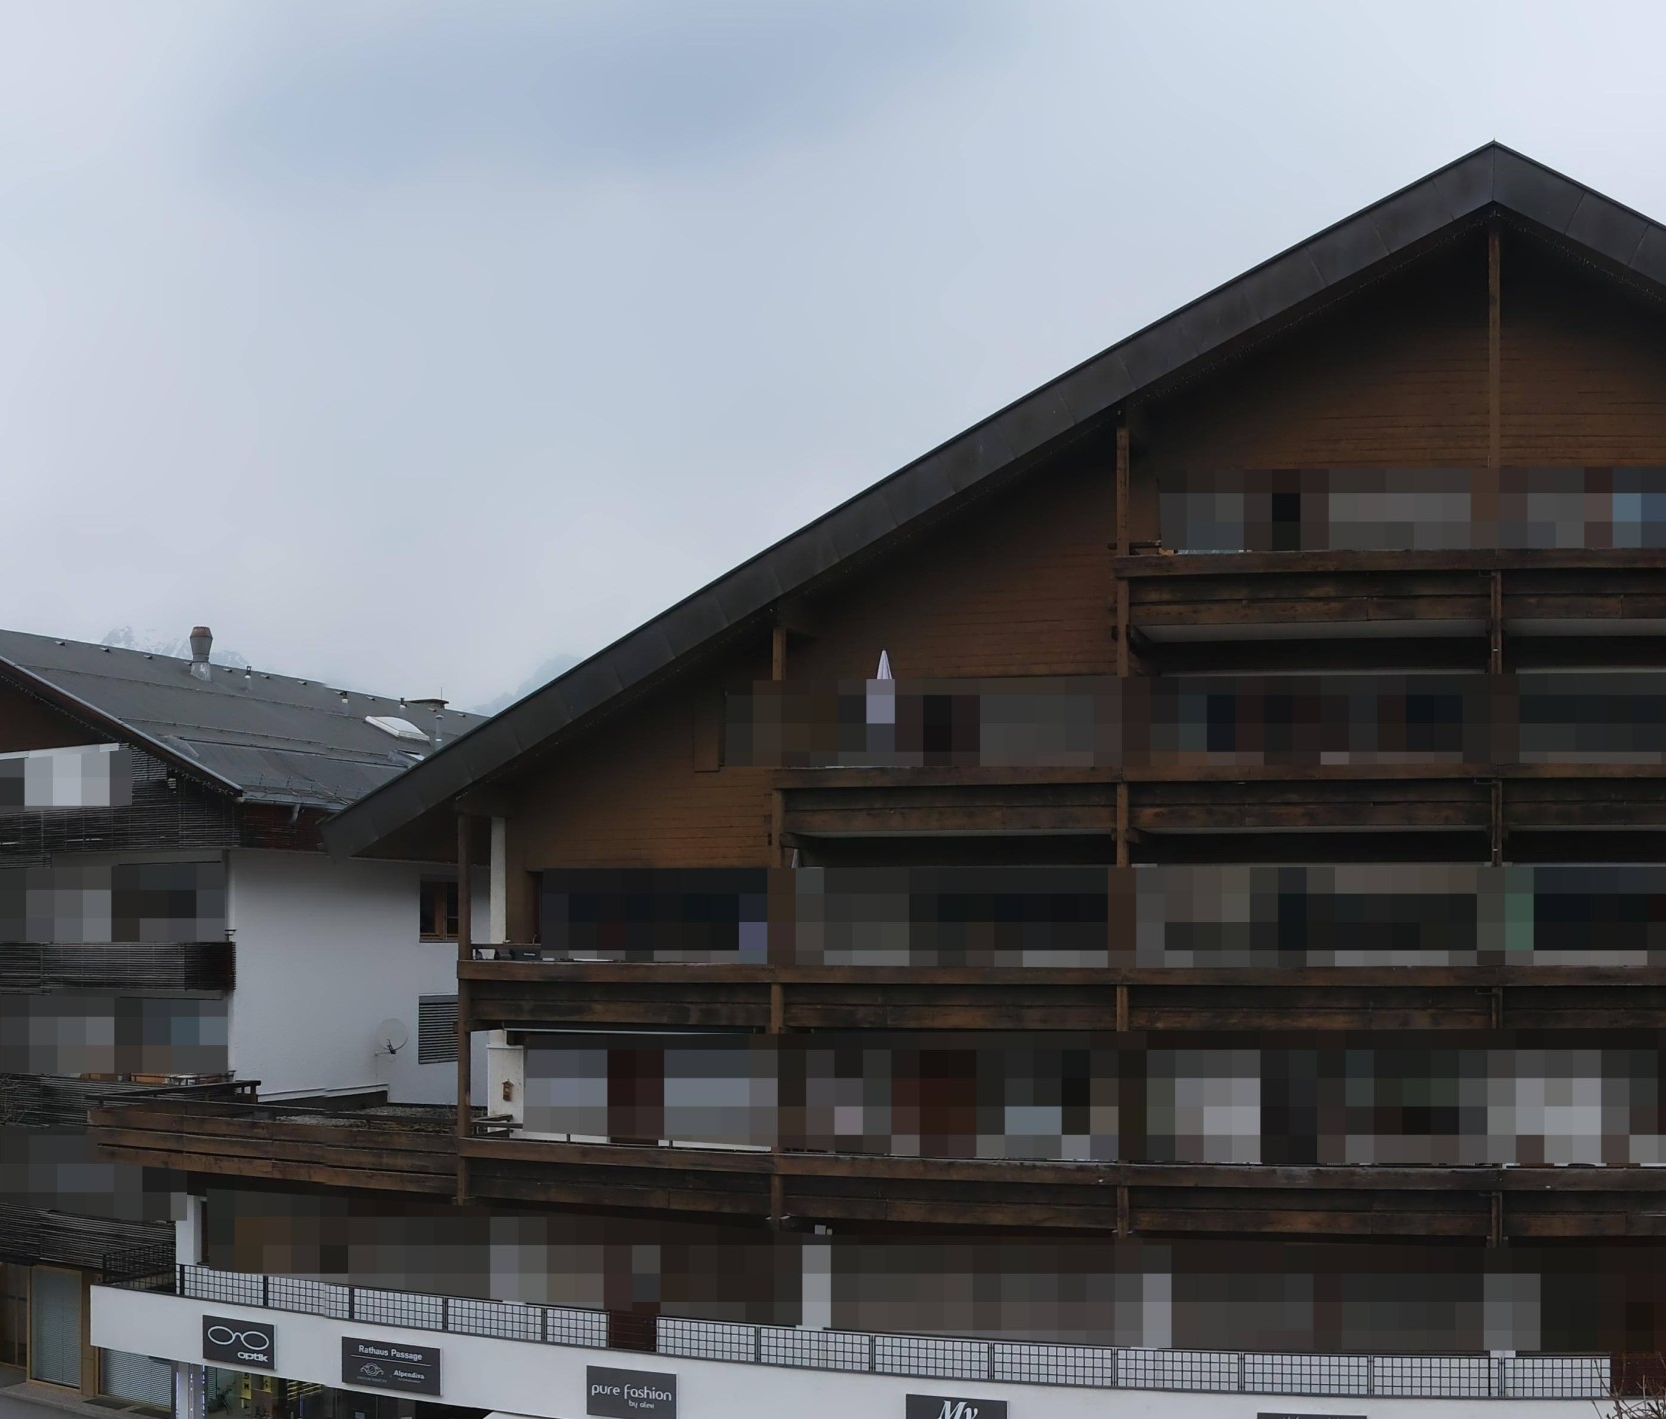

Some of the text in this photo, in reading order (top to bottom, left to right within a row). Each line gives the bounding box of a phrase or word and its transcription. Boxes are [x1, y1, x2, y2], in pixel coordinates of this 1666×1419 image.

[237, 1351, 268, 1363] optik
[358, 1345, 423, 1361] Rathaus Passage
[591, 1384, 672, 1401] pure fashion
[628, 1400, 638, 1409] by
